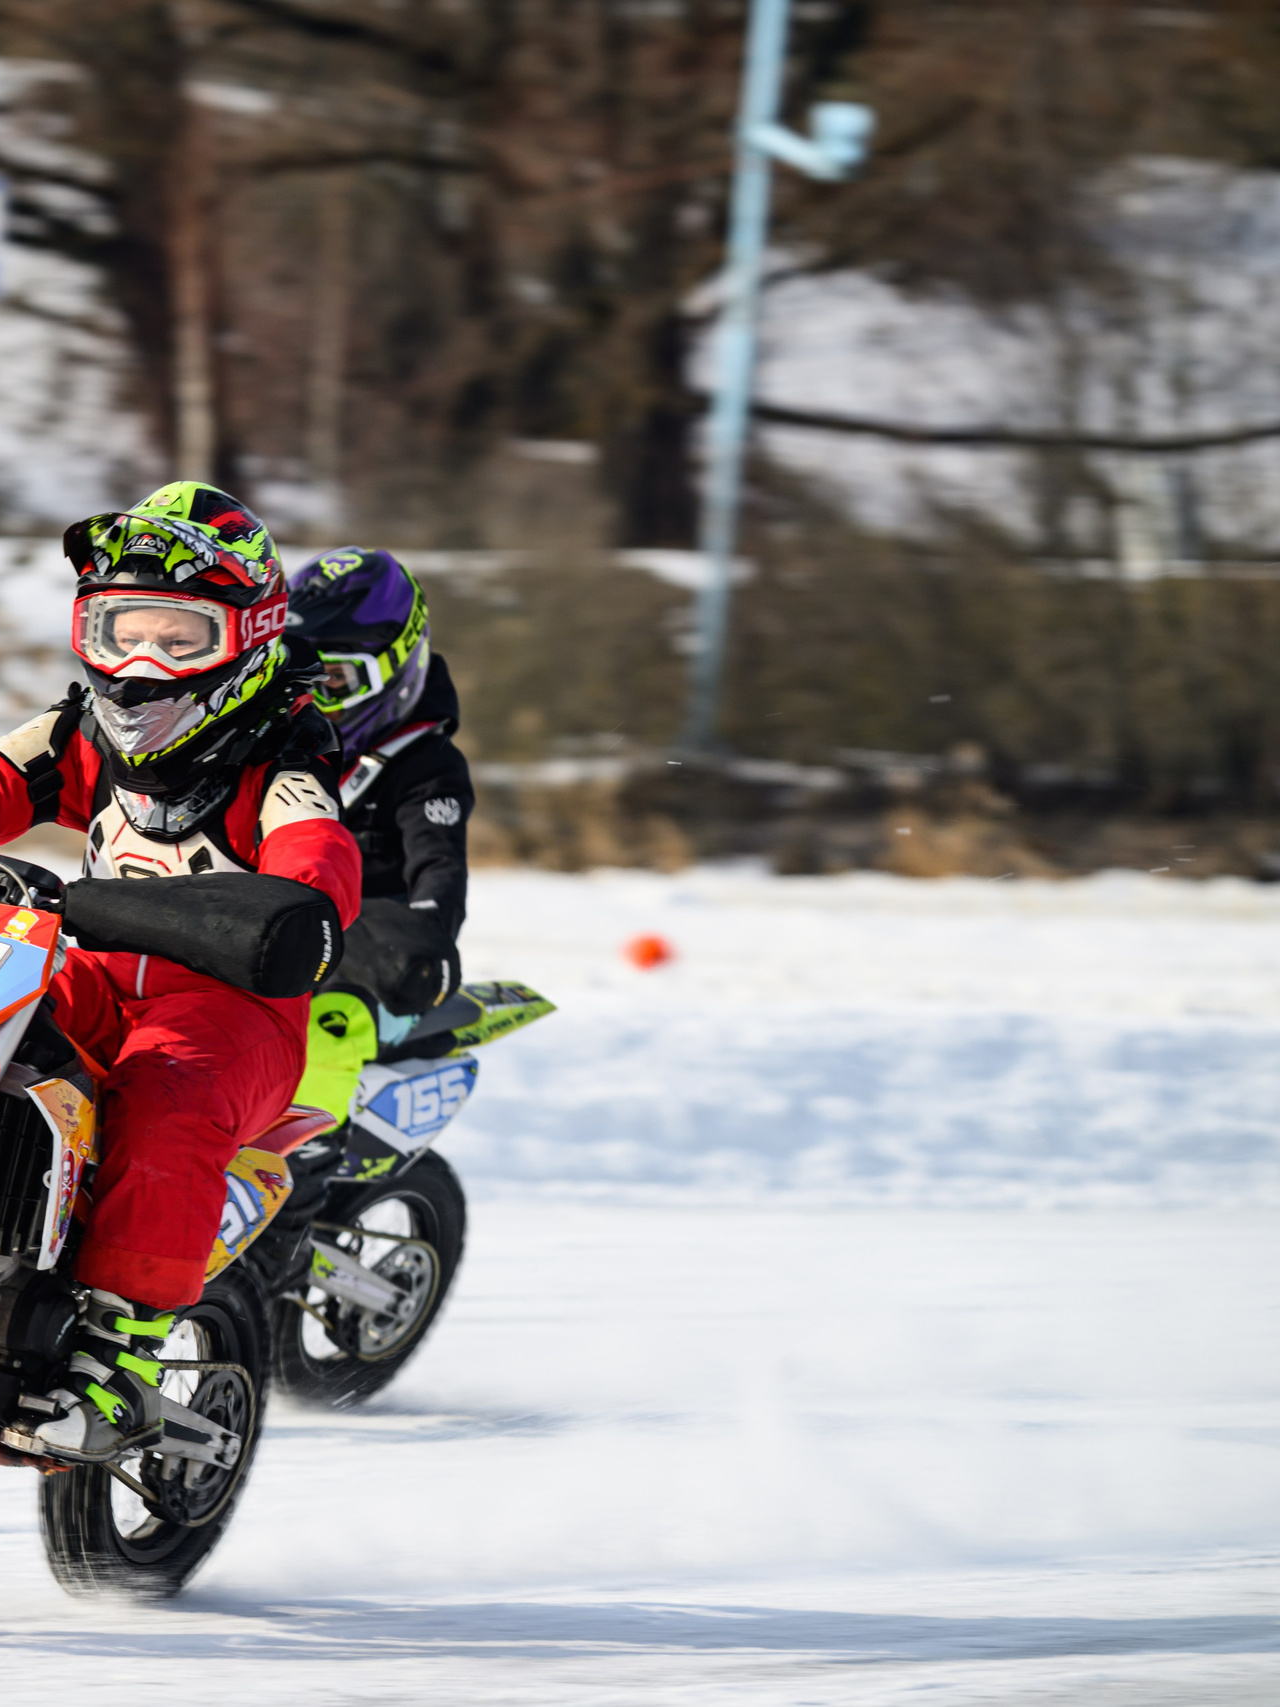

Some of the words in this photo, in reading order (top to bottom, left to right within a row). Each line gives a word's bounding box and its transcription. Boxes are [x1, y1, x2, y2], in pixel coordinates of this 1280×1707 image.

[124, 534, 167, 551] Airoh
[253, 601, 289, 640] SC
[393, 1066, 468, 1130] 155
